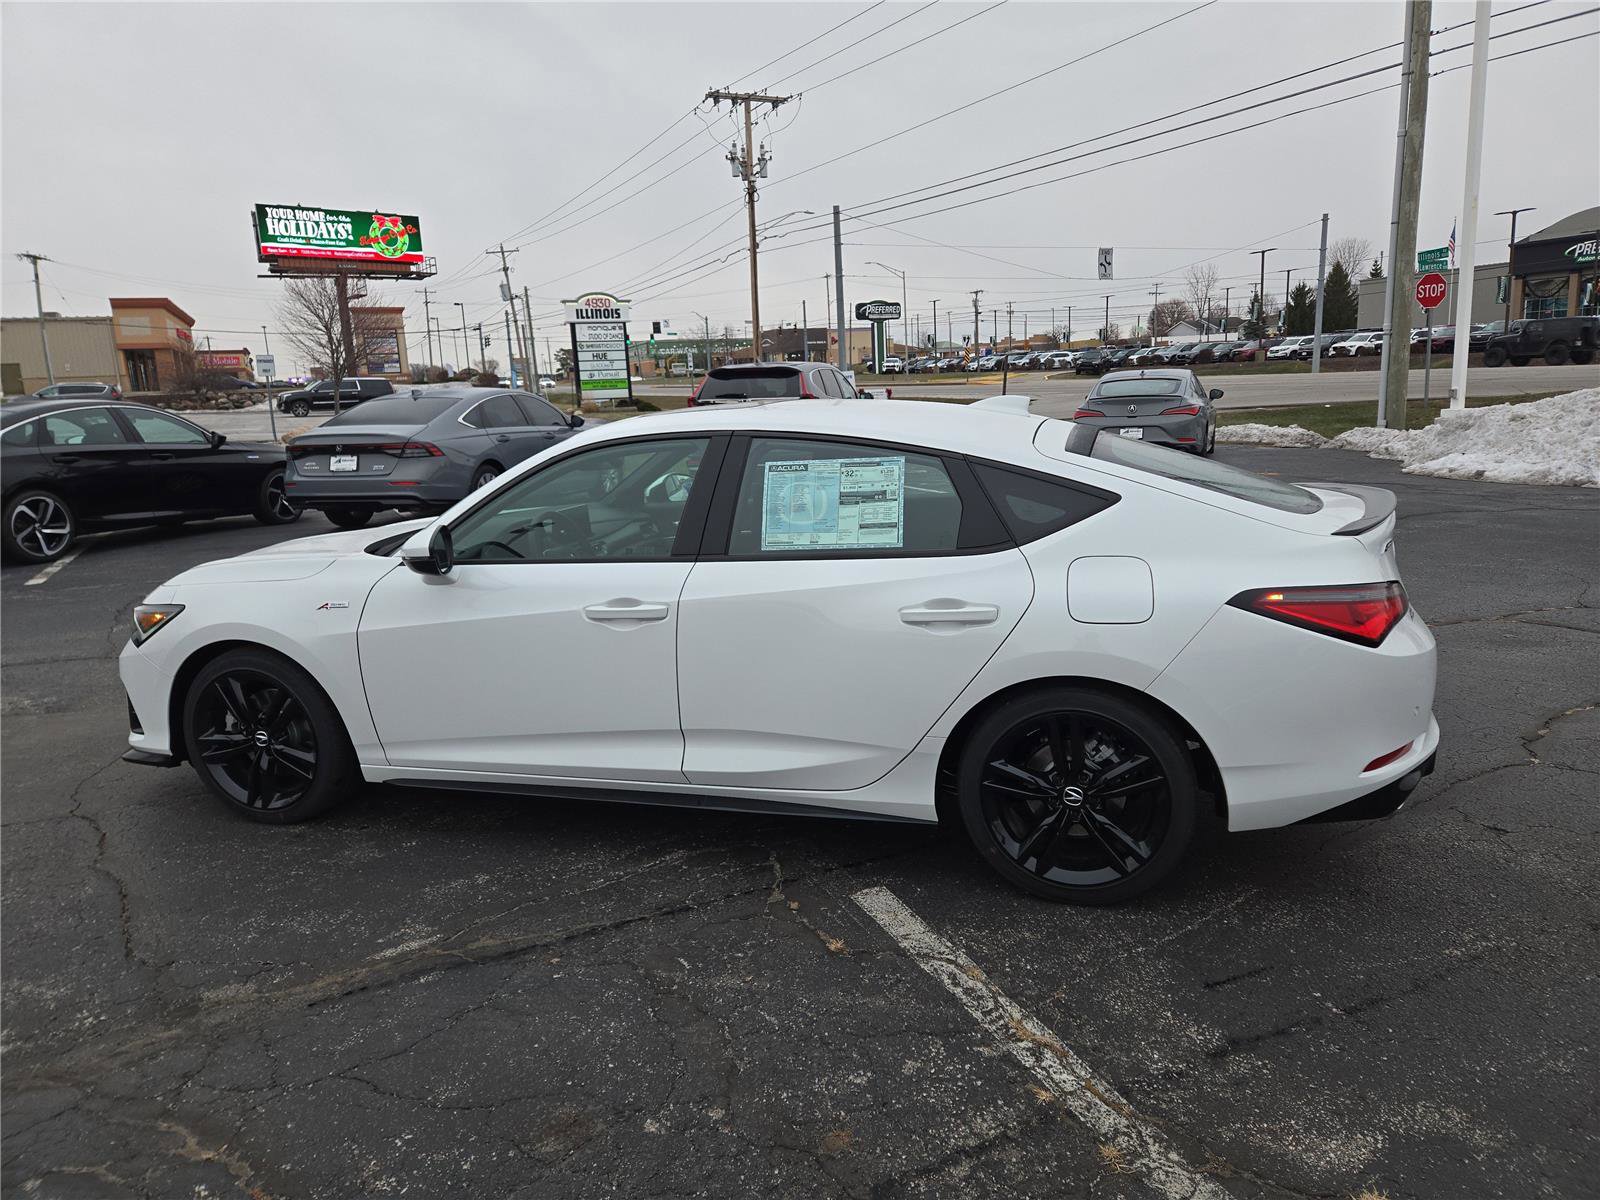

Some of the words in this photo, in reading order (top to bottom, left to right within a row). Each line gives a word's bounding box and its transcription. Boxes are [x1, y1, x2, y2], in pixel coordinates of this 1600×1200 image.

[265, 207, 295, 220] YOUR
[295, 209, 326, 222] HOME
[265, 217, 354, 240] HOLIDAYS!
[1419, 263, 1442, 272] Lawrence
[1417, 283, 1445, 298] STOP
[584, 298, 611, 308] 4930
[575, 308, 621, 320] ILLINOIS
[865, 304, 901, 316] PREFERRED
[592, 352, 608, 360] HUE
[844, 470, 855, 478] 32
